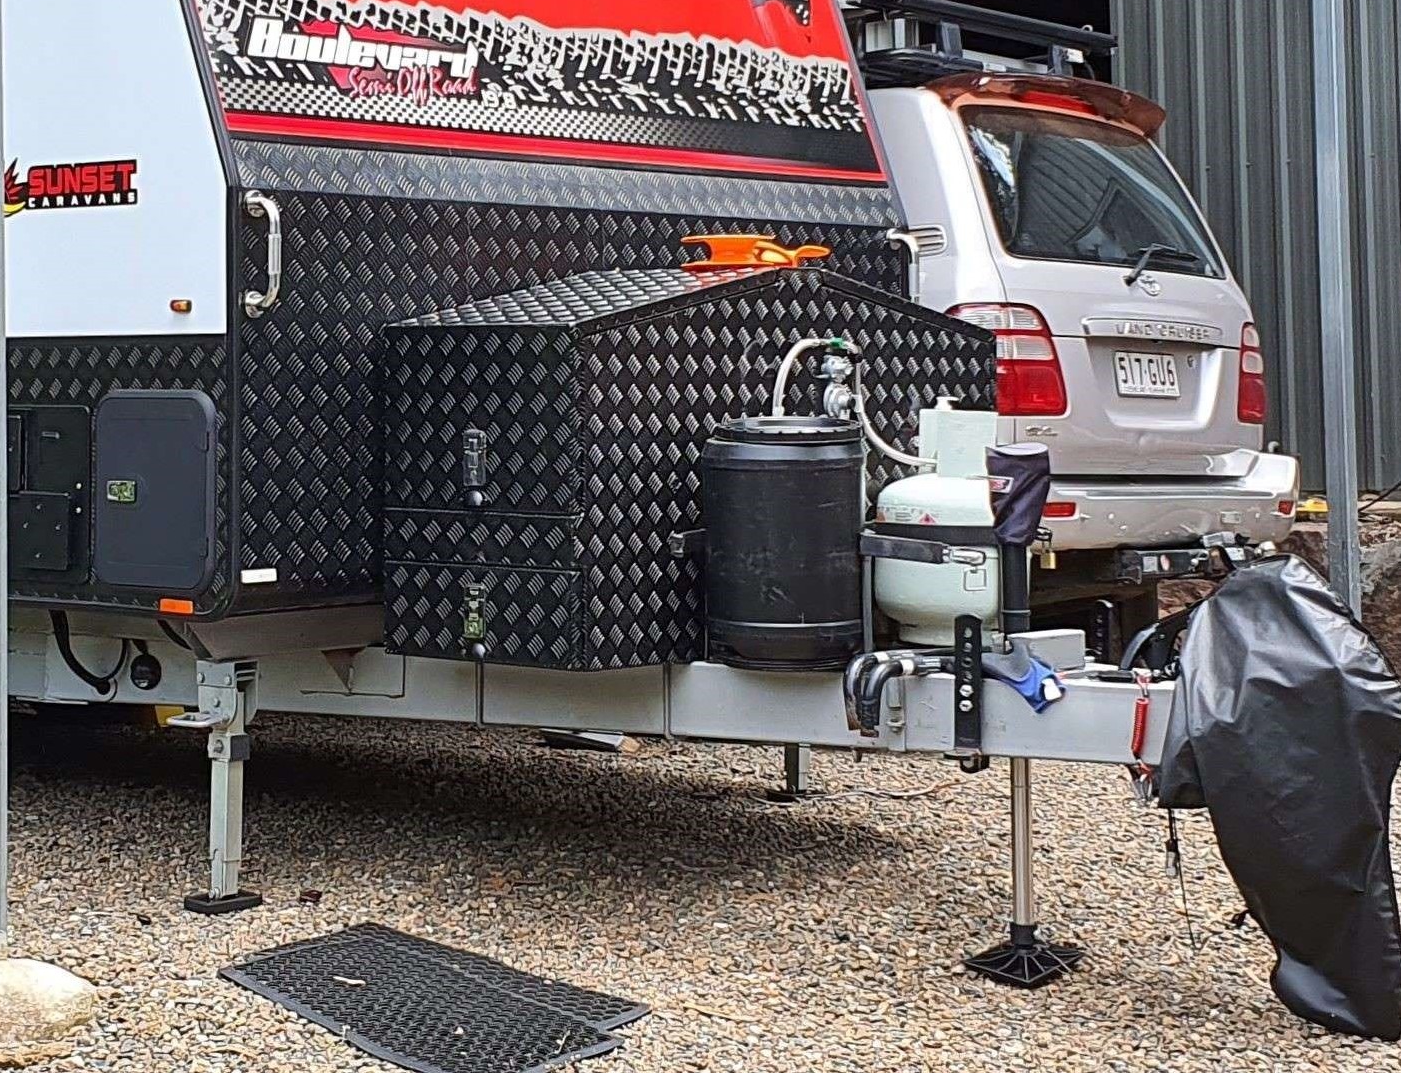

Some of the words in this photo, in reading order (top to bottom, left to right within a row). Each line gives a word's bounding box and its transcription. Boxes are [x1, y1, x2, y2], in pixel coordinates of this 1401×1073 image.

[247, 17, 479, 78] Boulevard
[349, 66, 396, 98] Semi
[28, 163, 135, 196] SUNSET
[28, 191, 136, 208] CARAVANS
